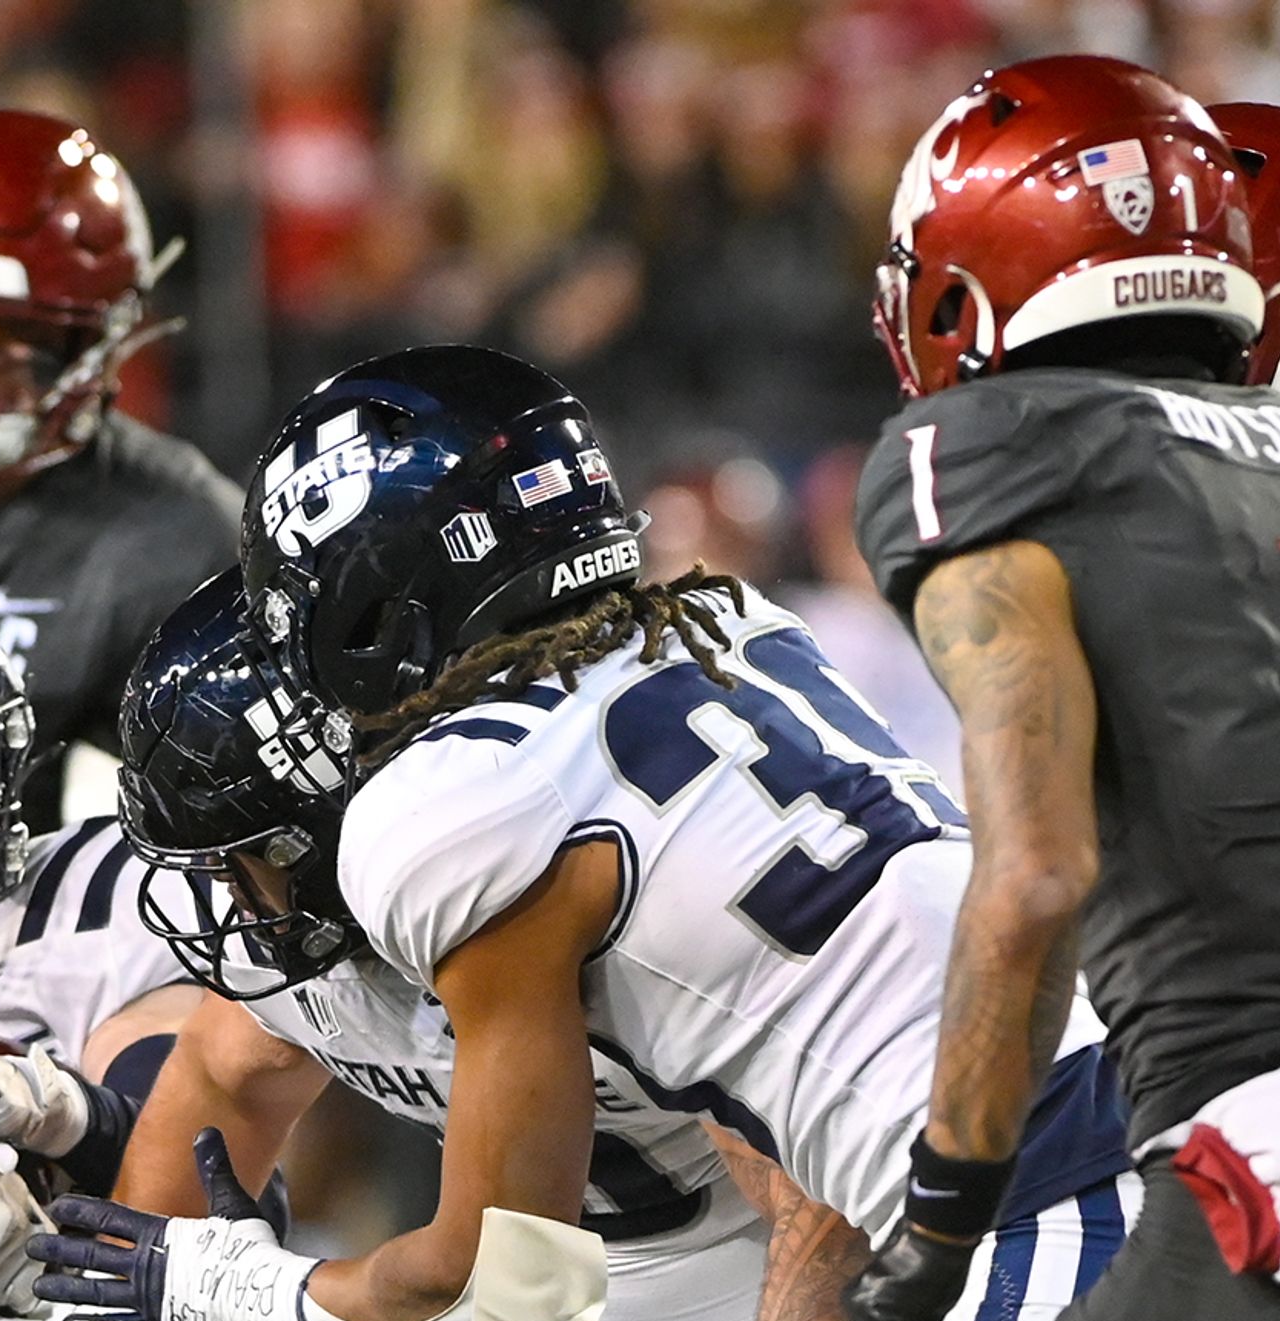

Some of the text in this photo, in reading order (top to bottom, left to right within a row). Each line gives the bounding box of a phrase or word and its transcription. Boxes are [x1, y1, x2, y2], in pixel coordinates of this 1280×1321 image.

[1114, 269, 1228, 308] COUGARS
[261, 432, 377, 538] STATE
[902, 423, 944, 543] 1
[551, 539, 641, 598] AGGIES
